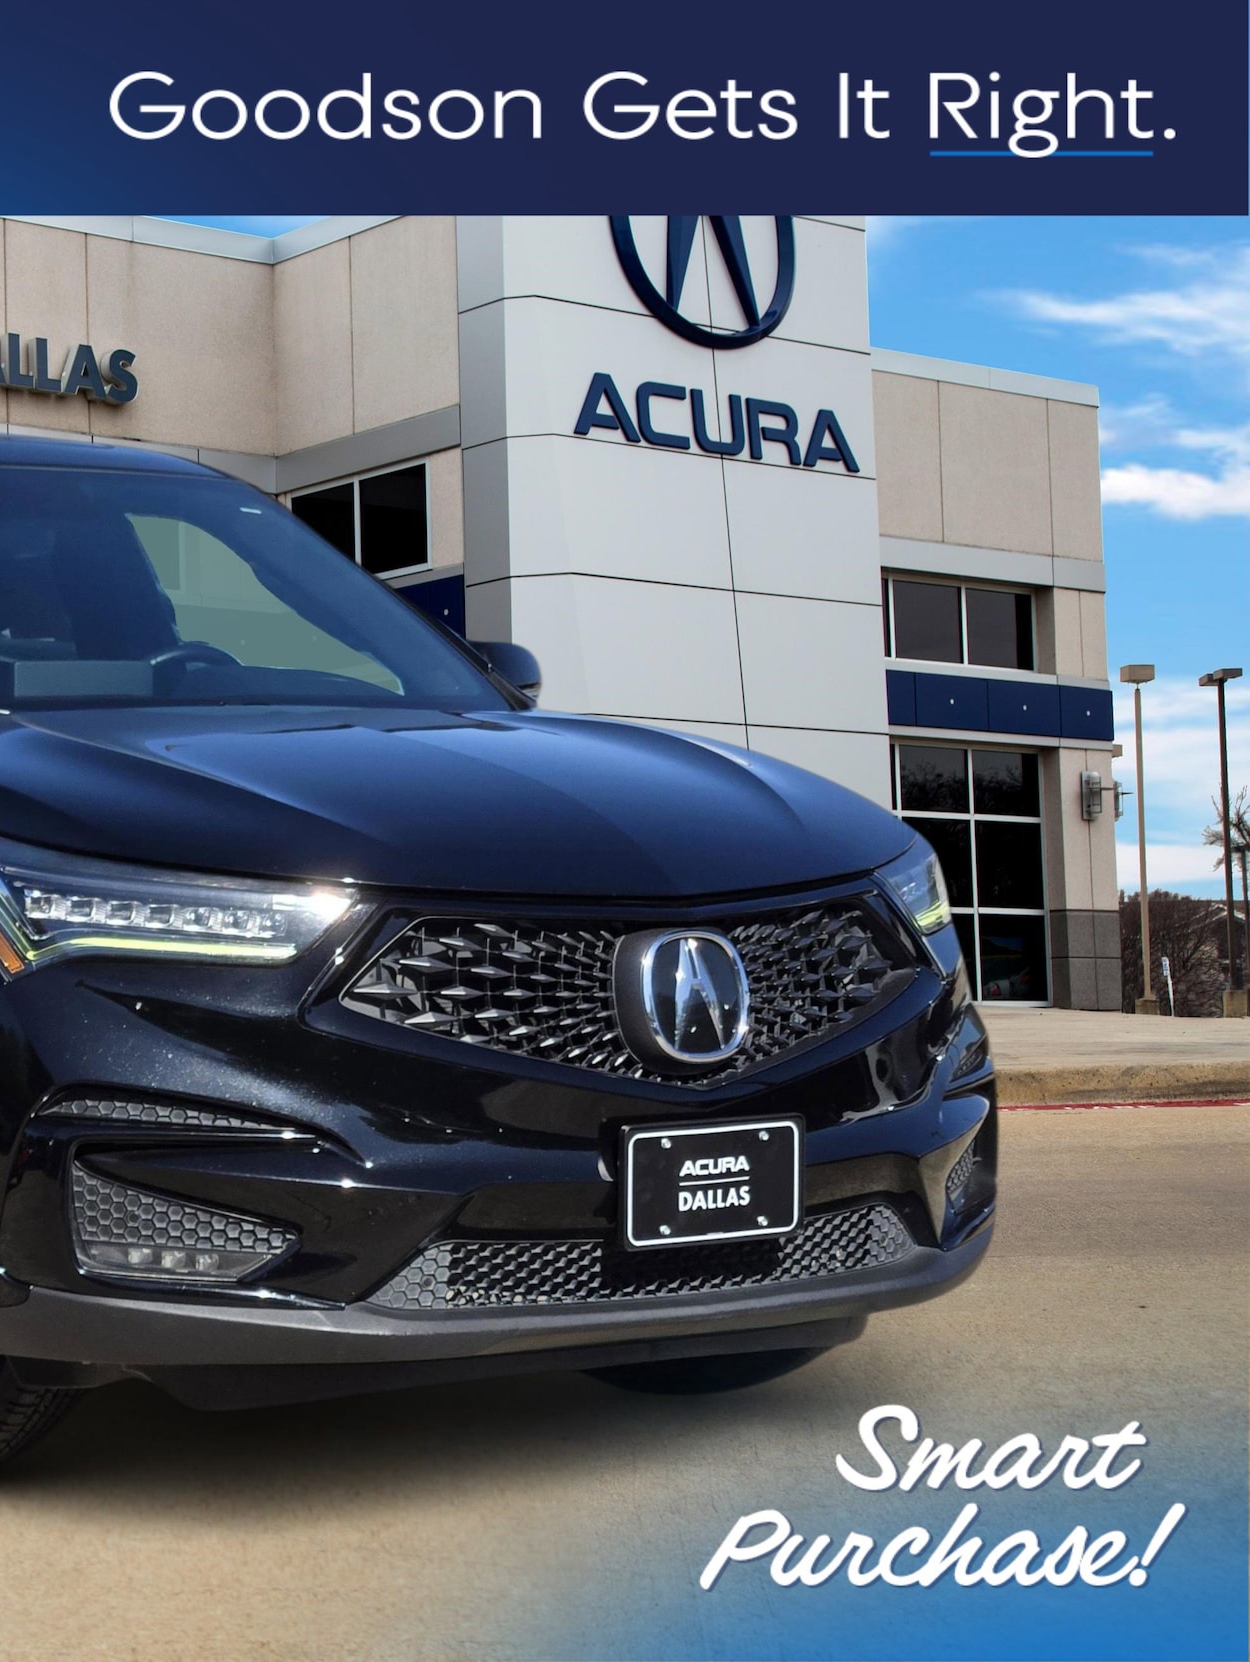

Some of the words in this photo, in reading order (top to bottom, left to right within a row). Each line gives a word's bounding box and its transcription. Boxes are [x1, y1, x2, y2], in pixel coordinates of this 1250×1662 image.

[573, 372, 861, 473] ACURA
[679, 1155, 750, 1177] ACURA
[678, 1185, 751, 1212] DALLAS
